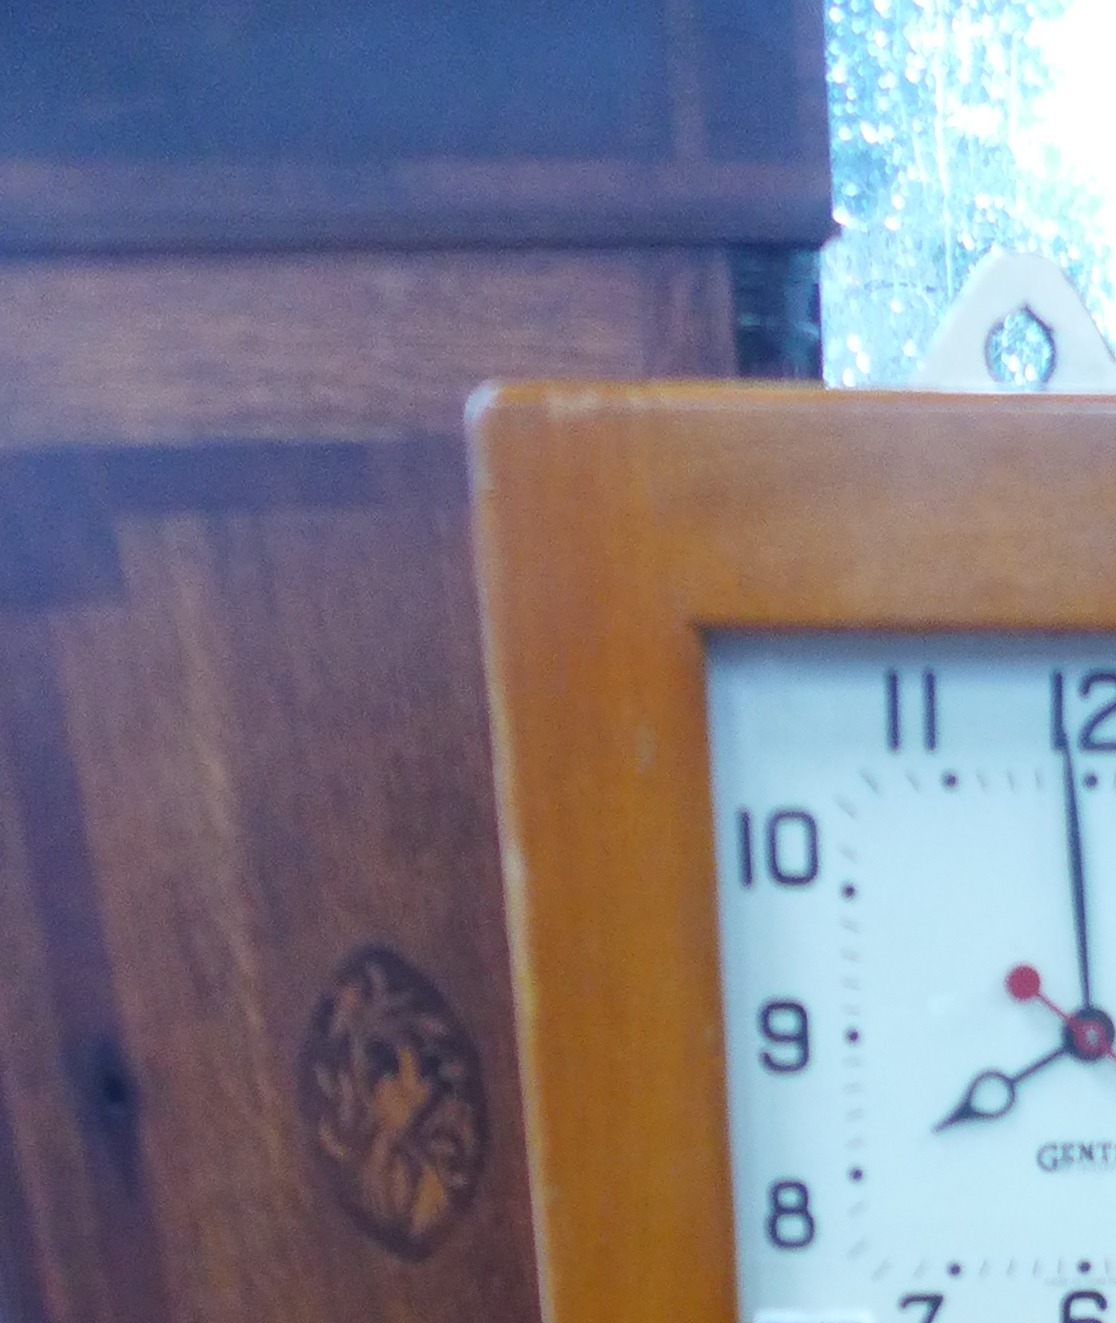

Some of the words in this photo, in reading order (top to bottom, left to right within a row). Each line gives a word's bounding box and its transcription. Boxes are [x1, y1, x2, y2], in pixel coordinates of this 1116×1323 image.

[885, 669, 937, 753] 11
[737, 808, 821, 889] 10
[757, 997, 811, 1076] 9
[764, 1178, 817, 1252] 8
